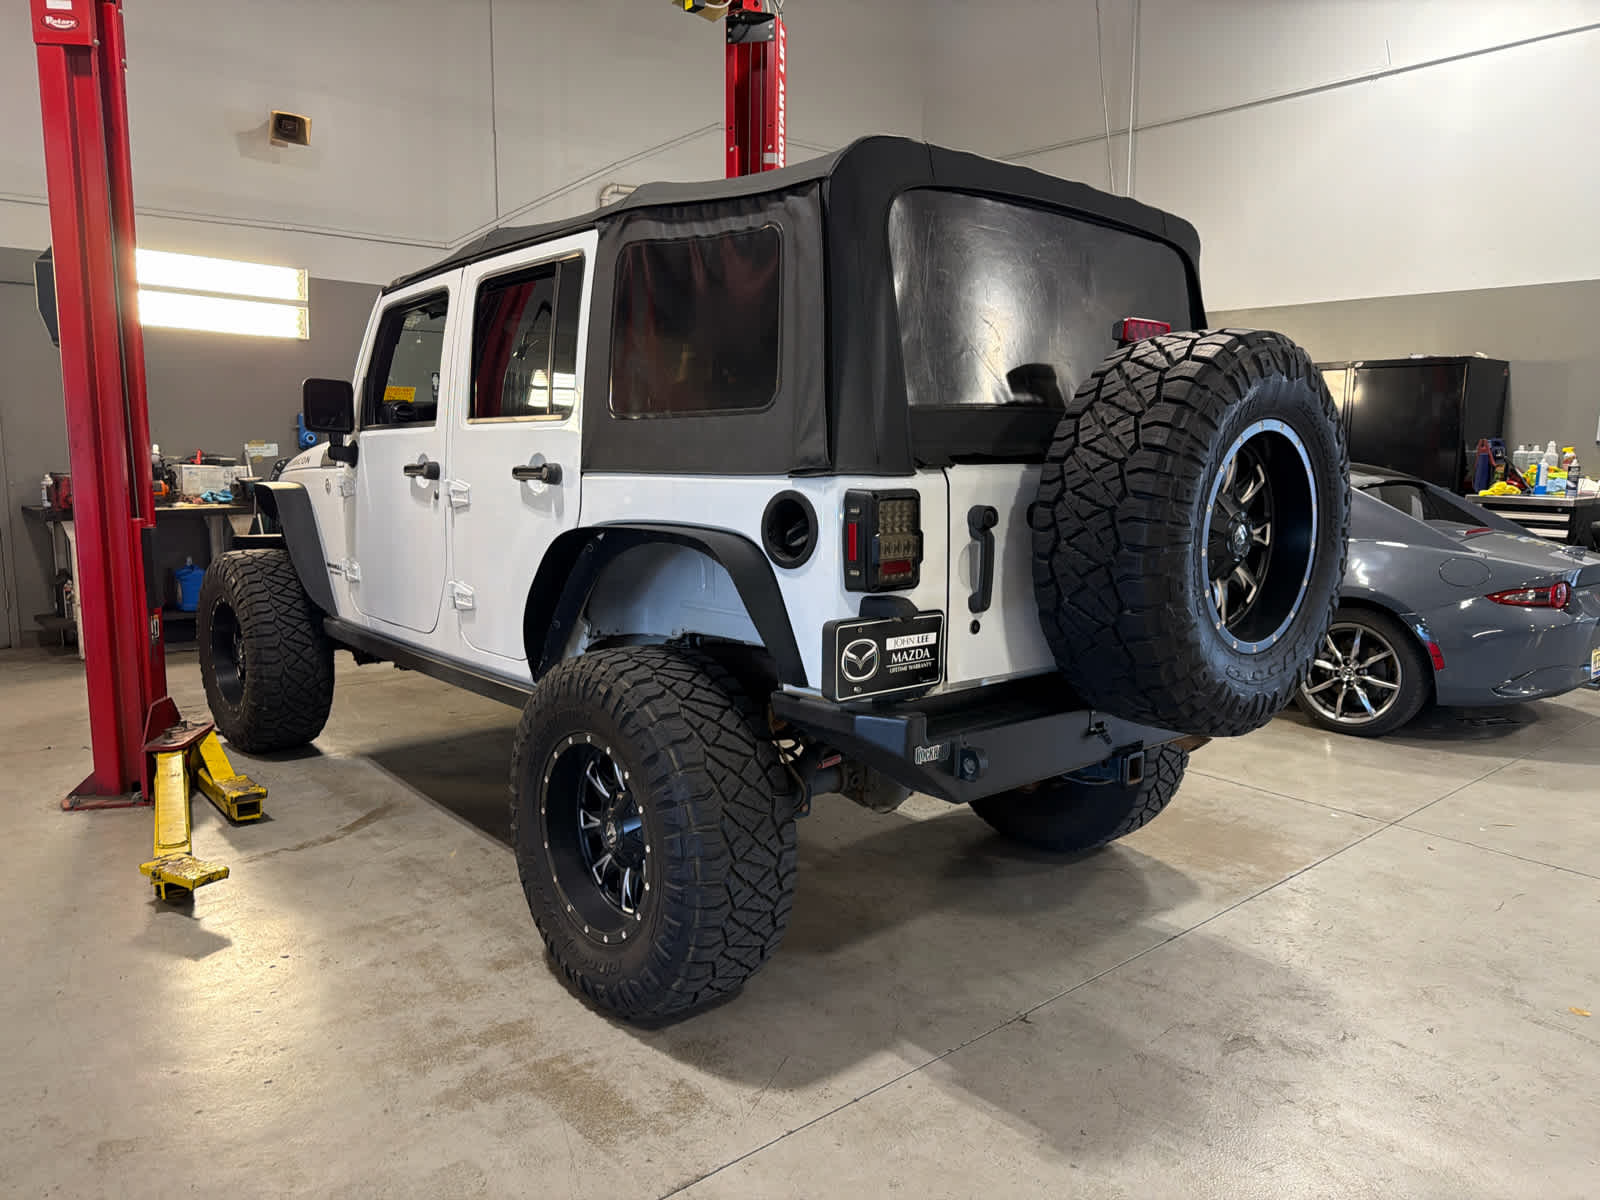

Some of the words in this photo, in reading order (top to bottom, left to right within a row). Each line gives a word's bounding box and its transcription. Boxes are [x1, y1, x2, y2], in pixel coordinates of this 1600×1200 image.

[45, 16, 75, 28] Rotary
[894, 637, 915, 648] JOHN
[917, 635, 929, 644] LEE
[892, 649, 931, 664] MAZDA
[909, 662, 932, 671] WARRANTY
